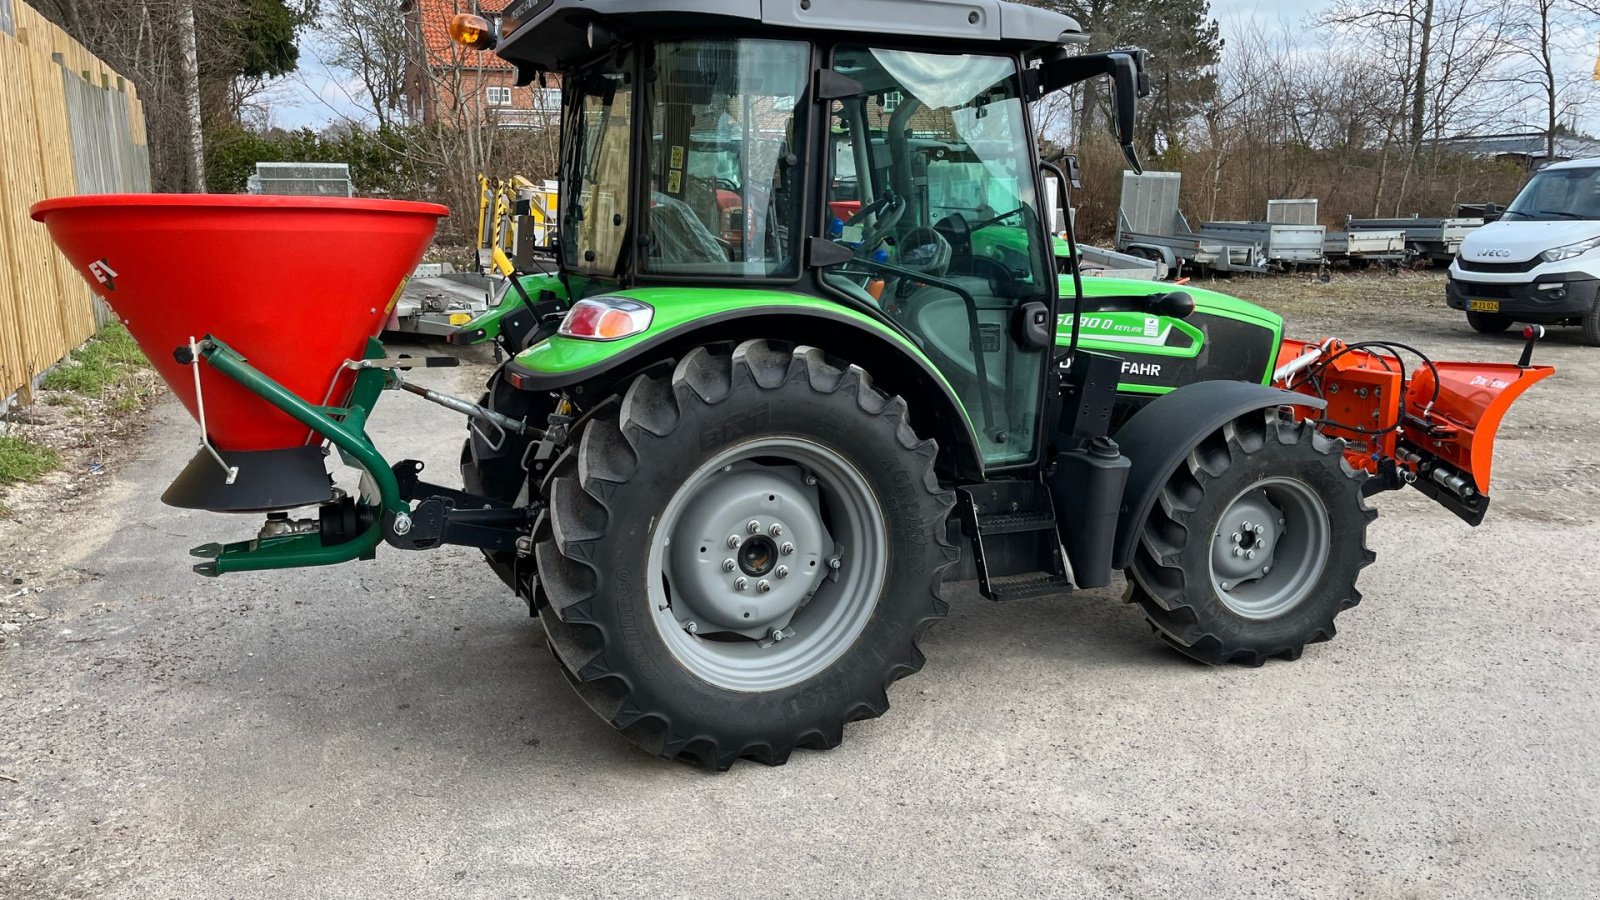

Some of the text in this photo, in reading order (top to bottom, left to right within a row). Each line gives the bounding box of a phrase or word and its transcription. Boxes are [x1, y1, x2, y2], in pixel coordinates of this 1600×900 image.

[1476, 248, 1512, 258] IVECO
[1101, 318, 1113, 330] D
[1114, 325, 1144, 334] KEYLINE
[1120, 361, 1161, 377] FAHR
